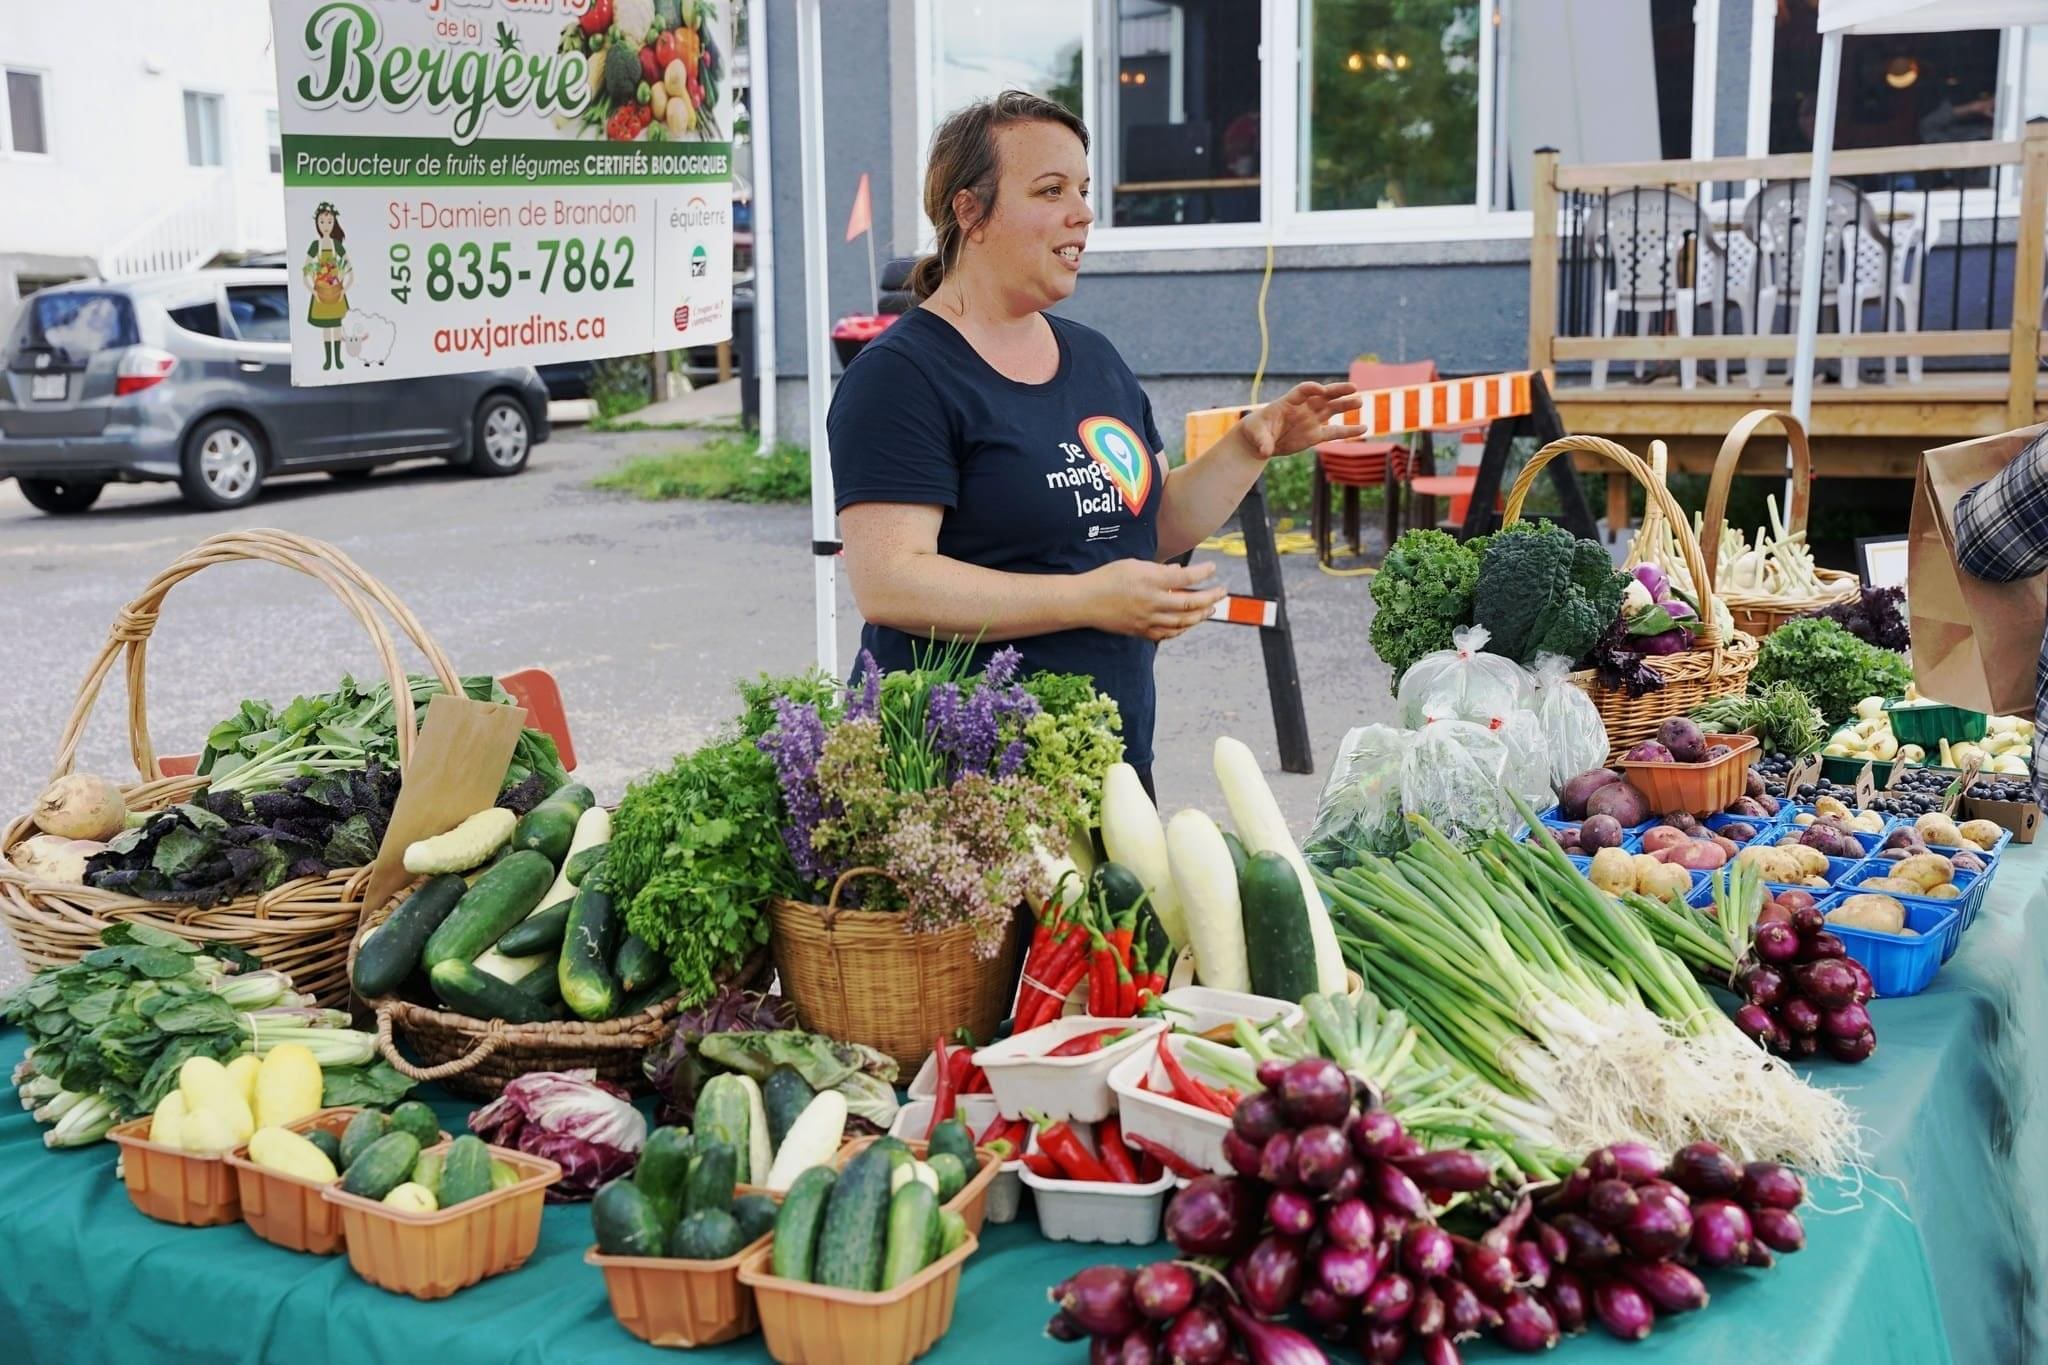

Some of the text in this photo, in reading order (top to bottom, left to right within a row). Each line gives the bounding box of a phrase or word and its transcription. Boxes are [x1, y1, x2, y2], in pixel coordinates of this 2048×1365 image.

[437, 20, 477, 38] de la
[297, 2, 588, 138] Bergère
[296, 151, 728, 180] Producteur de fruits et légumes CERTIFIÉS BIOLOGIQUES
[389, 199, 636, 230] St-Damien de Brandon
[670, 207, 726, 232] équiterre
[389, 243, 412, 304] 450
[426, 236, 635, 302] 835-7862
[433, 314, 606, 356] auxjardins.ca
[1058, 442, 1085, 463] Je
[1046, 460, 1113, 491] mange
